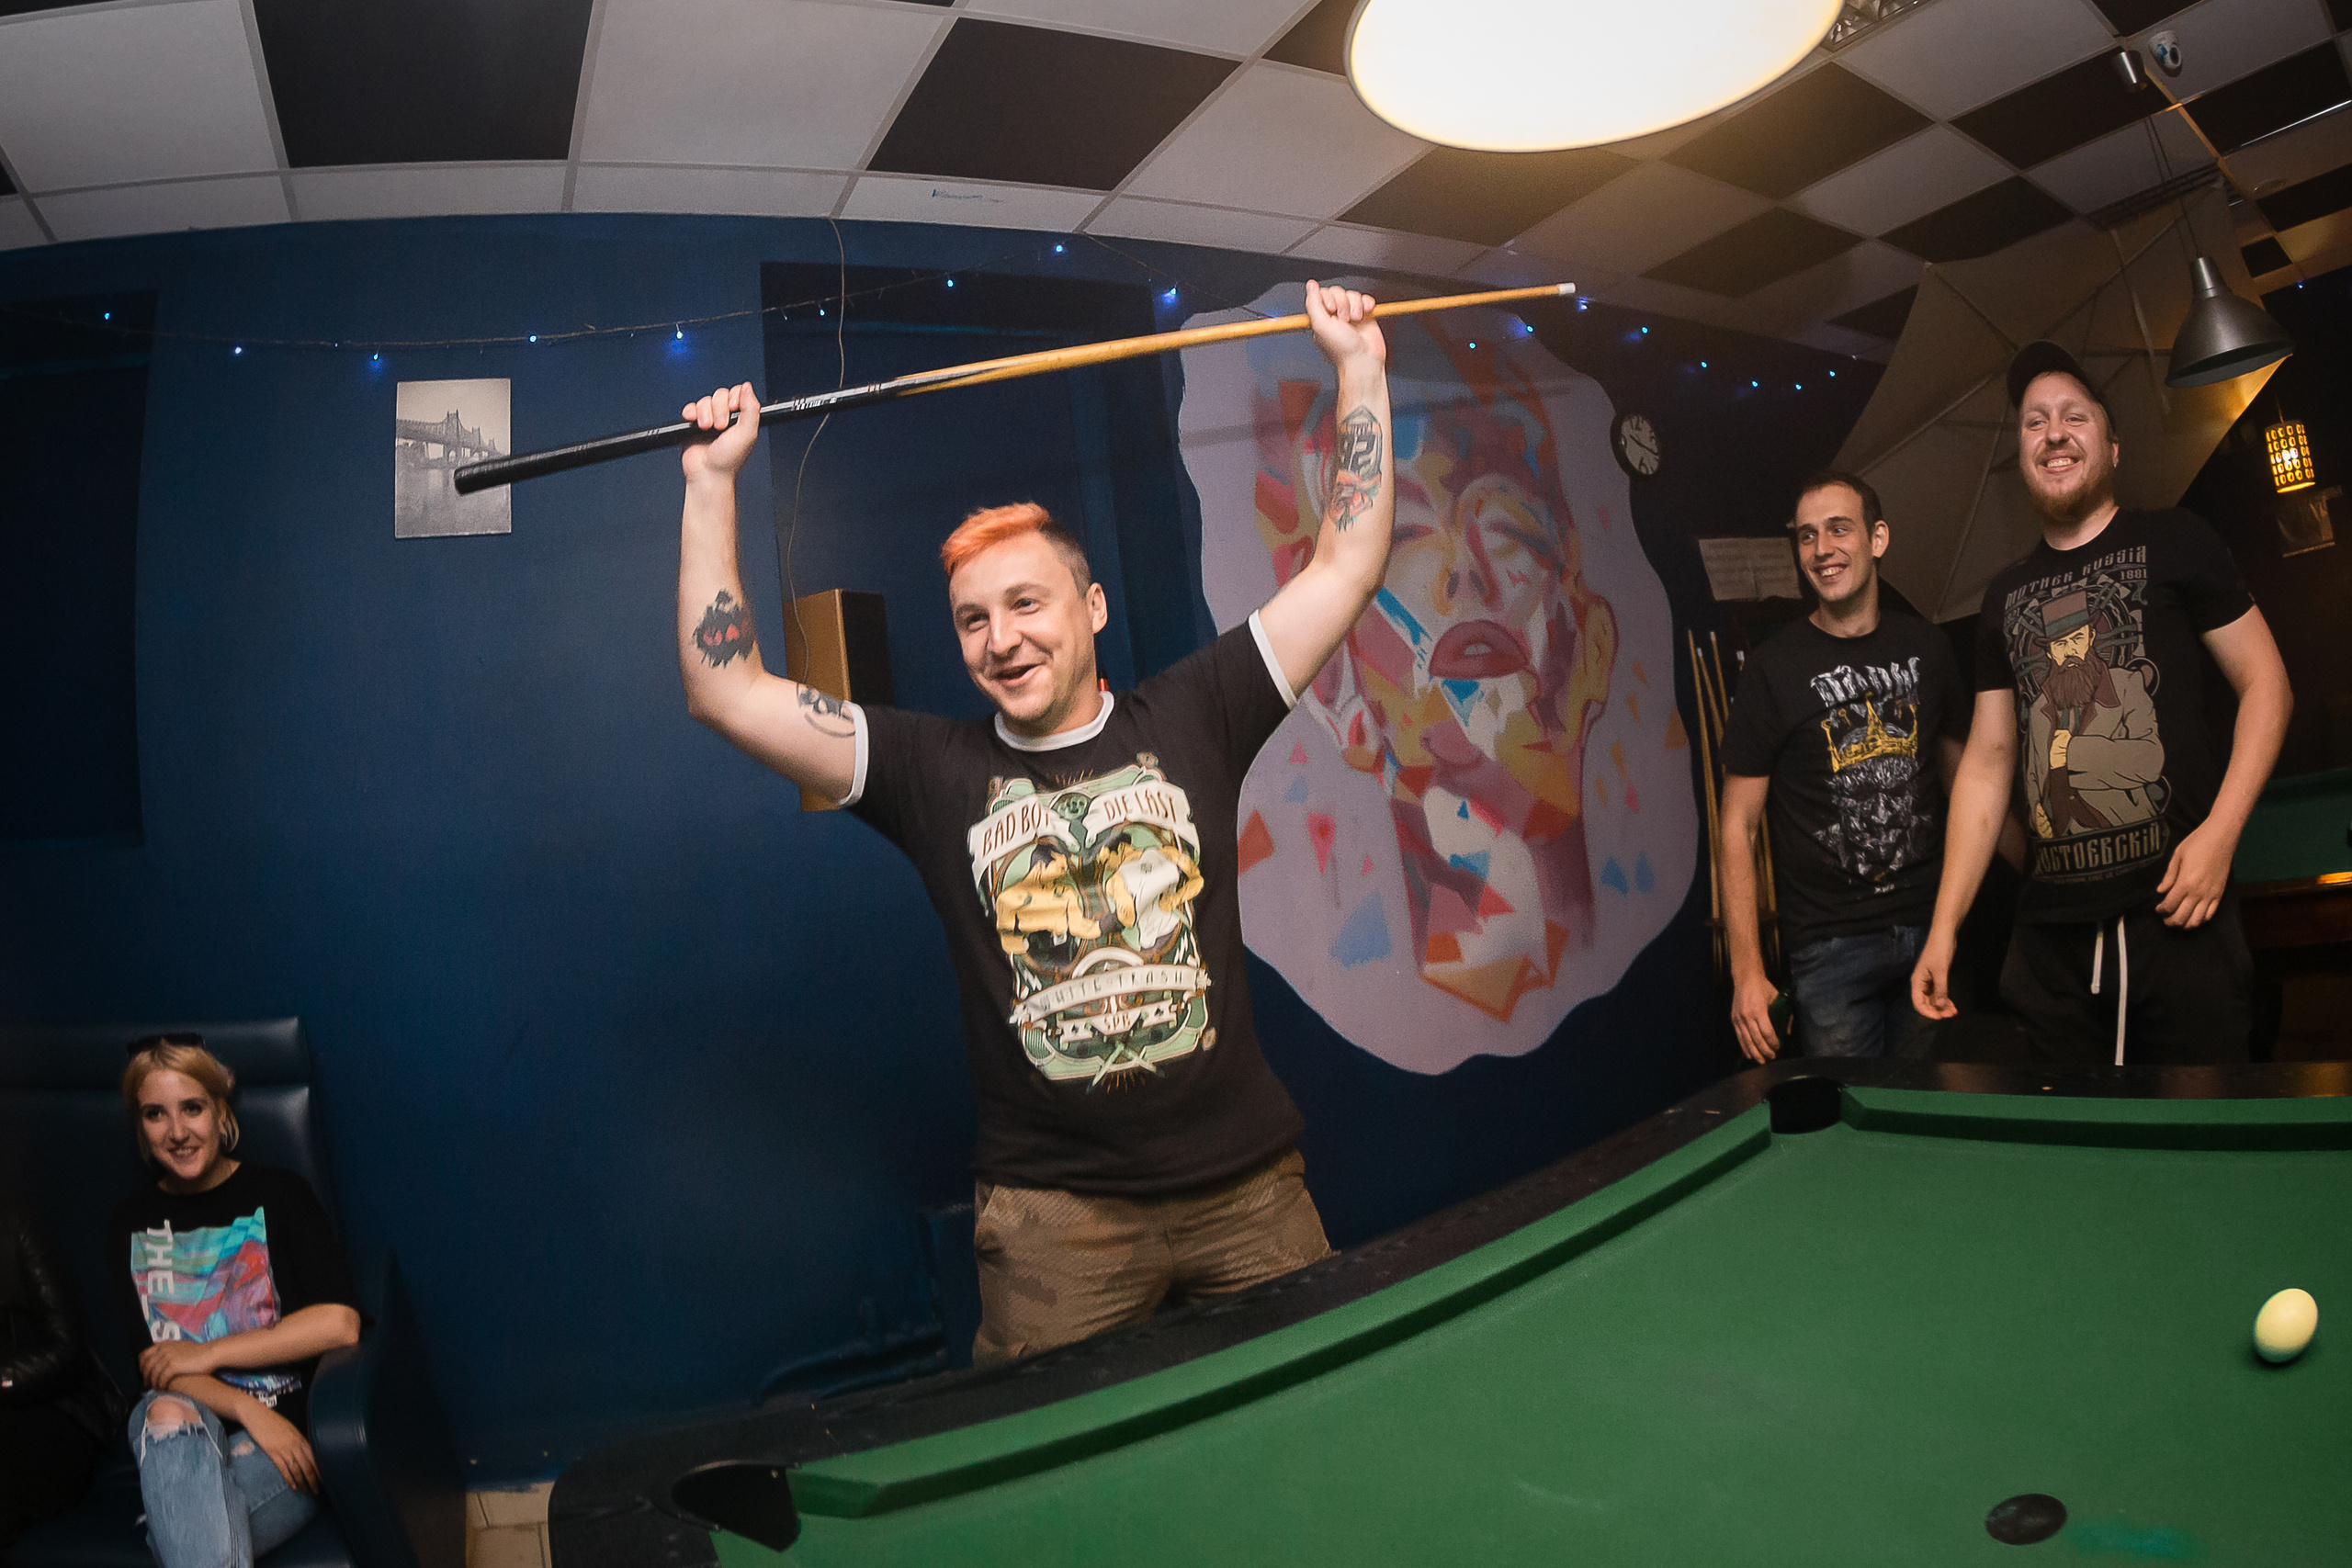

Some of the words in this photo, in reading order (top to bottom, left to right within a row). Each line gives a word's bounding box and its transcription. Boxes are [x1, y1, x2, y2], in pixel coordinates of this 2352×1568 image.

[2120, 568, 2148, 581] 1881
[982, 811, 1016, 857] BAD
[1103, 794, 1132, 821] DIE
[1135, 789, 1177, 824] LAST
